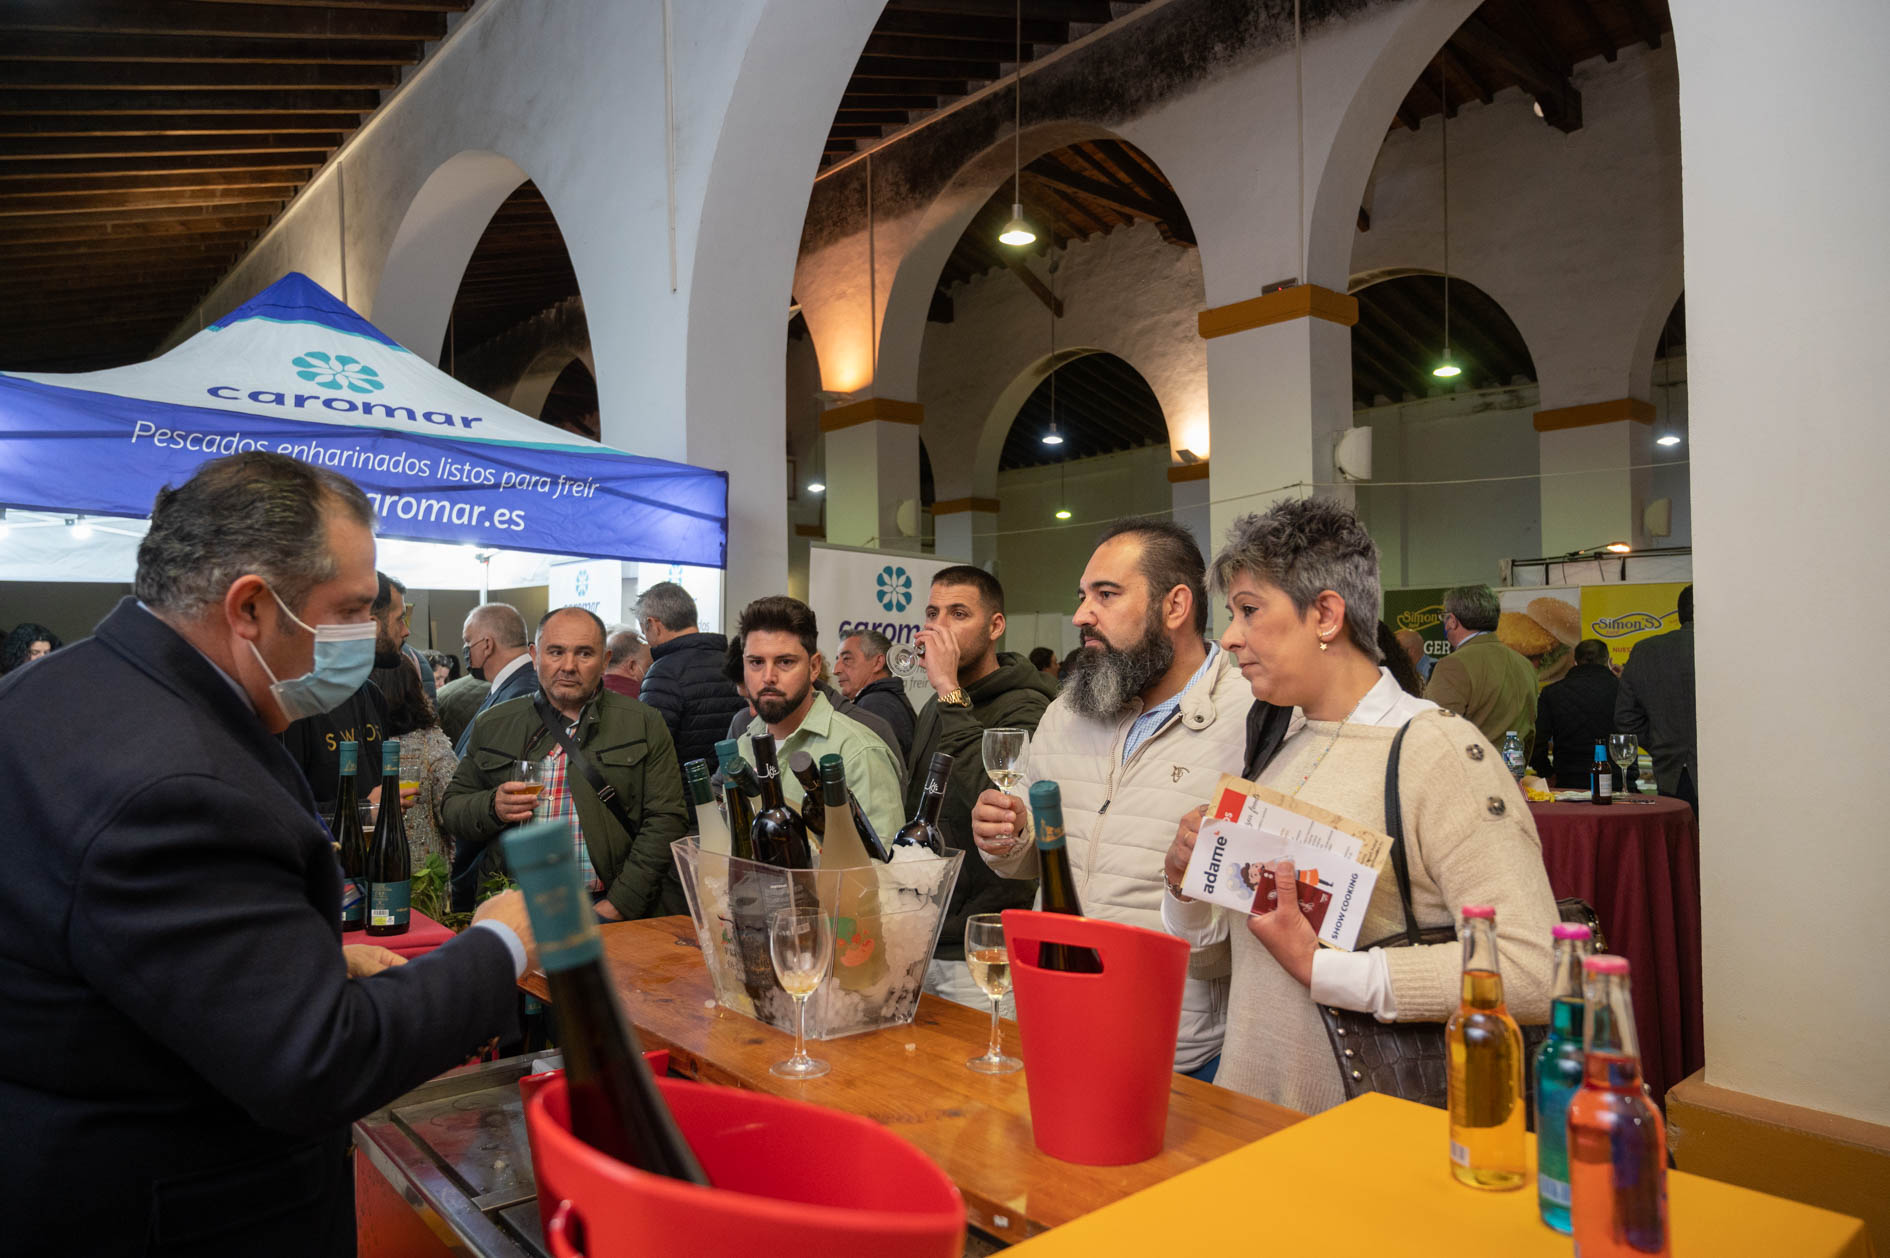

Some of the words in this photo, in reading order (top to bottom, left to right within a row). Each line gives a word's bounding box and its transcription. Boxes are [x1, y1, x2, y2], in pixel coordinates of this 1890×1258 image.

[206, 386, 483, 429] caromar
[131, 420, 269, 456] Pescados
[277, 441, 431, 477] enharinados
[437, 457, 496, 485] listos
[500, 470, 551, 491] para
[552, 475, 600, 500] freír
[367, 492, 526, 531] aromar.es
[1424, 640, 1451, 654] GER
[1203, 835, 1228, 894] adame
[1331, 911, 1346, 940] SHOW
[1341, 872, 1359, 911] COOKING
